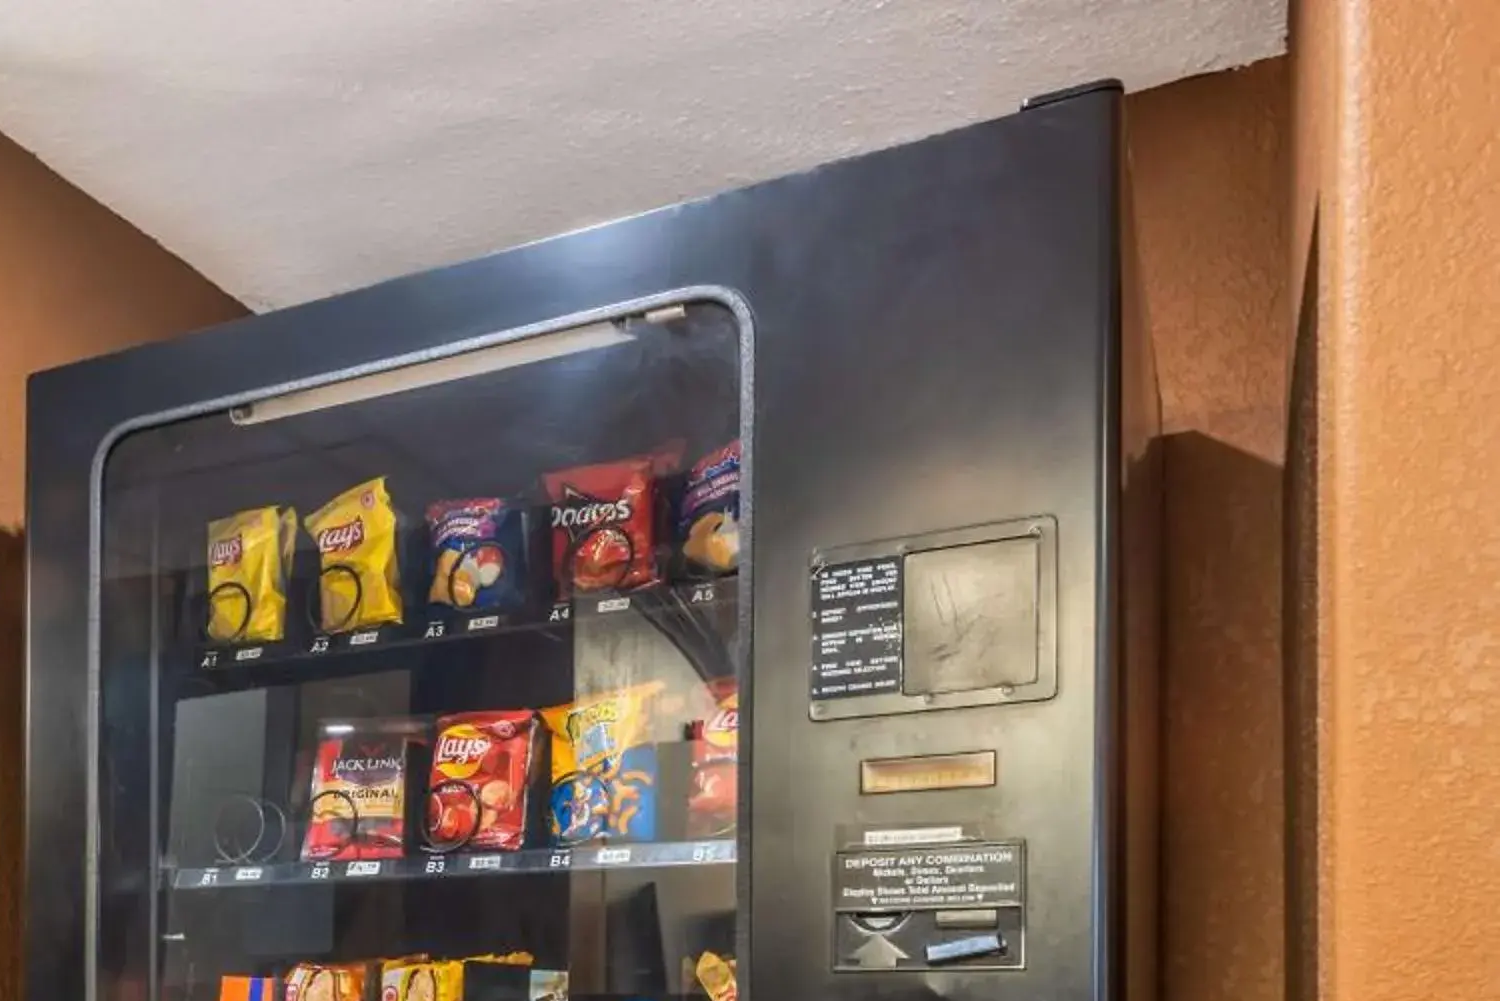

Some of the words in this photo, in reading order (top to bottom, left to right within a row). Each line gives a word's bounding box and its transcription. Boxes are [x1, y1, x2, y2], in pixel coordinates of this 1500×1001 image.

[549, 607, 569, 621] A4
[425, 625, 445, 638] A3
[310, 641, 329, 653] A2
[201, 655, 218, 668] A1
[332, 758, 364, 772] JACK
[333, 787, 399, 799] ORIGINAL
[550, 855, 570, 867] B4
[845, 857, 896, 869] DEPOSIT
[898, 855, 922, 866] ANY
[925, 851, 1013, 865] COMBINATION
[311, 867, 330, 879] B2
[426, 861, 445, 873] B3
[200, 873, 218, 886] B1
